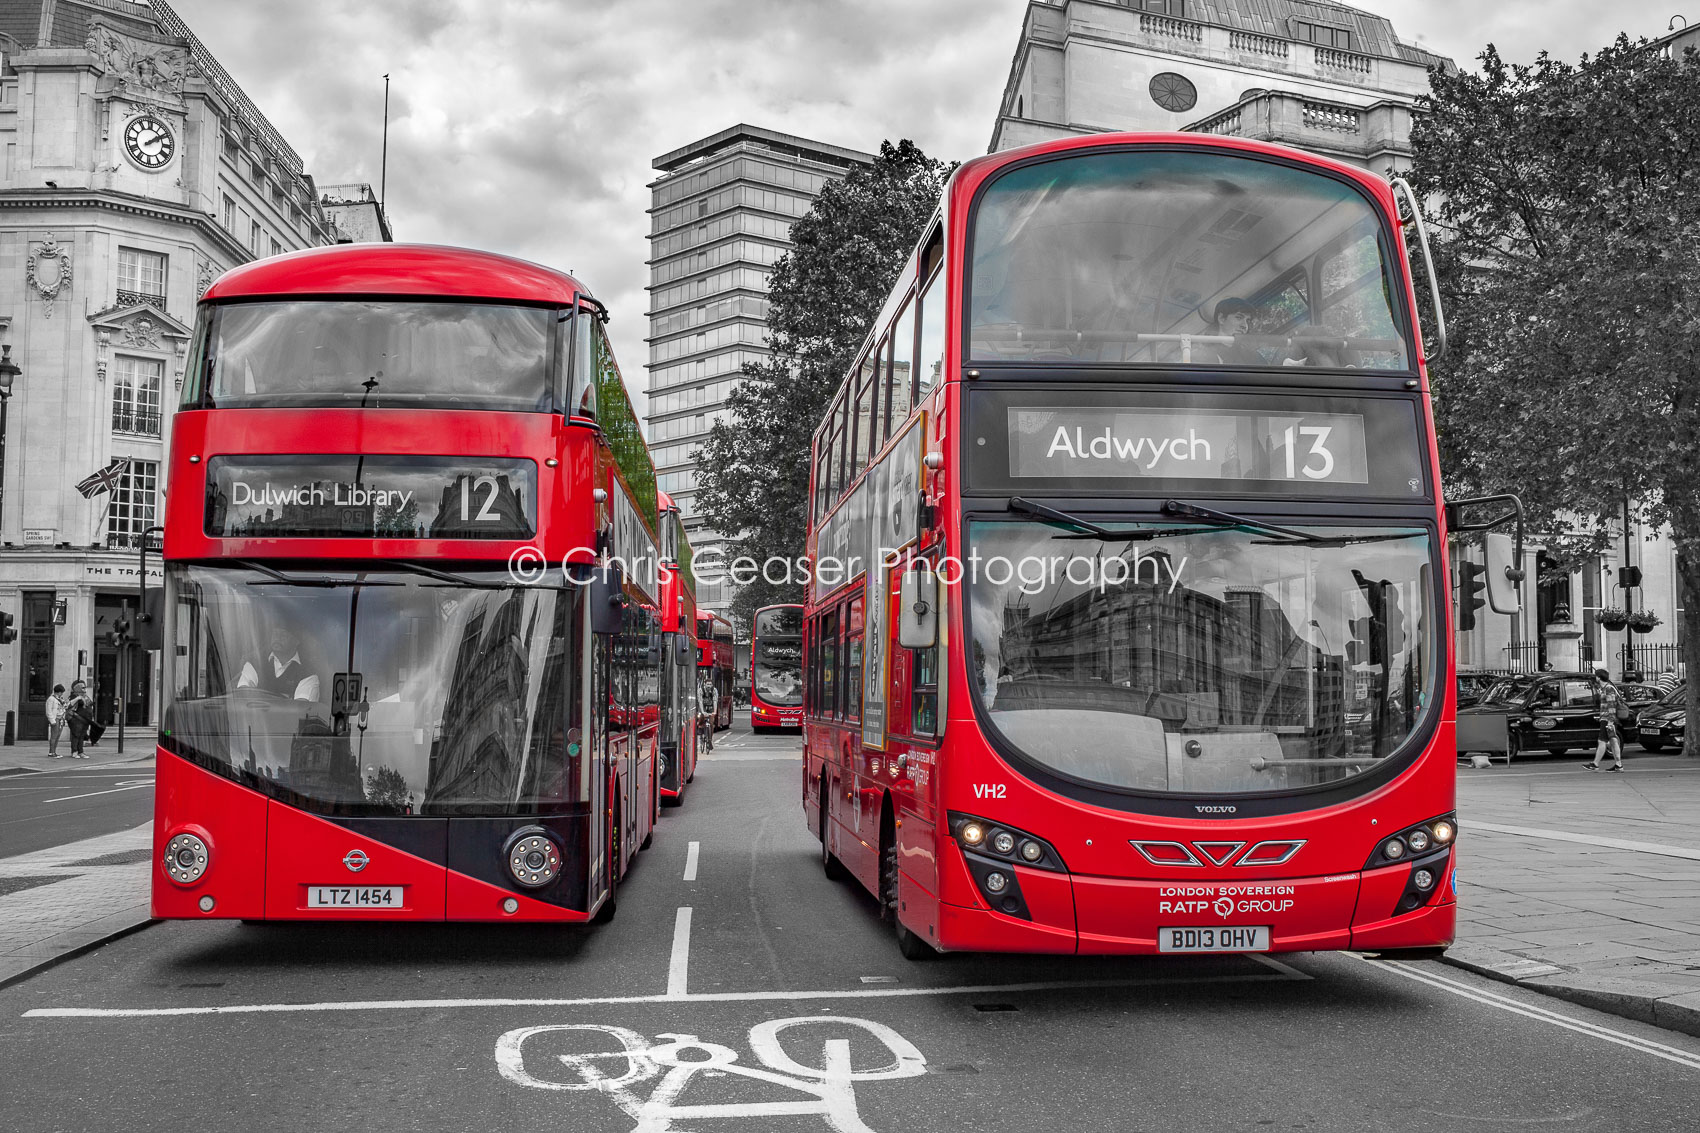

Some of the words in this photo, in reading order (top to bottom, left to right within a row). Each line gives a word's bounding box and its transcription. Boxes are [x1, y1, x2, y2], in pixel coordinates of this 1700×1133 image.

[1046, 425, 1211, 470] Aldwych
[1284, 425, 1334, 479] 13
[232, 481, 324, 506] Dulwich
[334, 481, 414, 513] Library
[460, 475, 501, 521] 12
[86, 567, 112, 575] THE
[767, 646, 794, 655] Aldwych
[973, 783, 1007, 799] VH2
[1195, 805, 1237, 813] VOLVO
[1324, 873, 1357, 883] Screenwash
[318, 889, 350, 905] LTZ
[355, 889, 392, 905] 1454
[1159, 886, 1214, 897] LONDON
[1218, 886, 1295, 896] SOVEREIGN
[1159, 900, 1209, 914] RATP
[1237, 899, 1294, 913] GROUP
[1172, 929, 1214, 948] BD13
[1220, 928, 1257, 947] OHV
